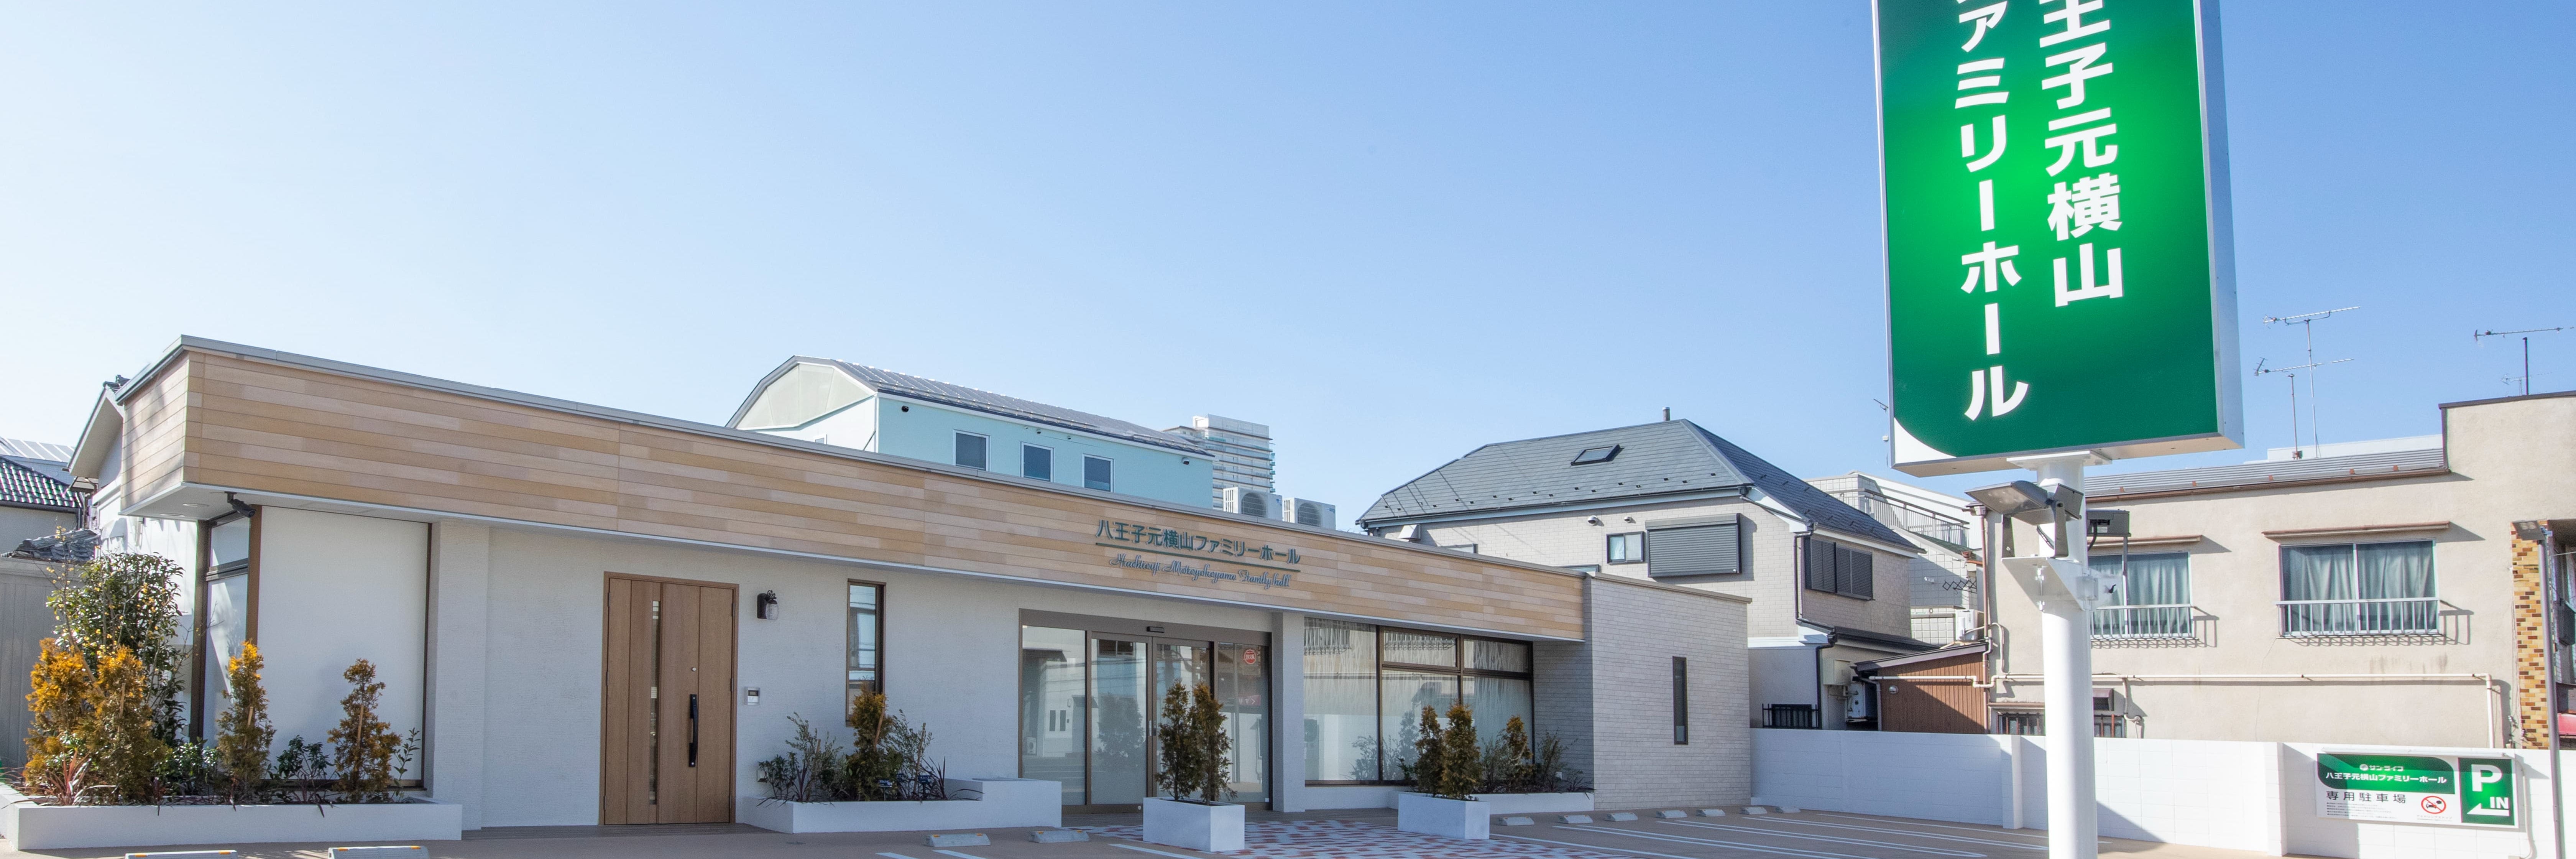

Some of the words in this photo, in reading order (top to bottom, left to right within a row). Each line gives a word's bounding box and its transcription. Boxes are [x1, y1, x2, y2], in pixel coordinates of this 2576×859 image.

[1955, 0, 2028, 421] ァミリーホール
[1096, 520, 1300, 564] 八王子元横山ファミリーホール
[1110, 553, 1160, 576] Hachiouji
[1163, 560, 1236, 584] Motoyokoyama
[1239, 570, 1271, 589] Family
[1273, 572, 1291, 586] hall
[2326, 772, 2447, 783] 八王子元横山ファミリーホール
[2471, 764, 2502, 792] P
[2326, 791, 2406, 803] 専用駐車場
[2490, 796, 2509, 809] IN
